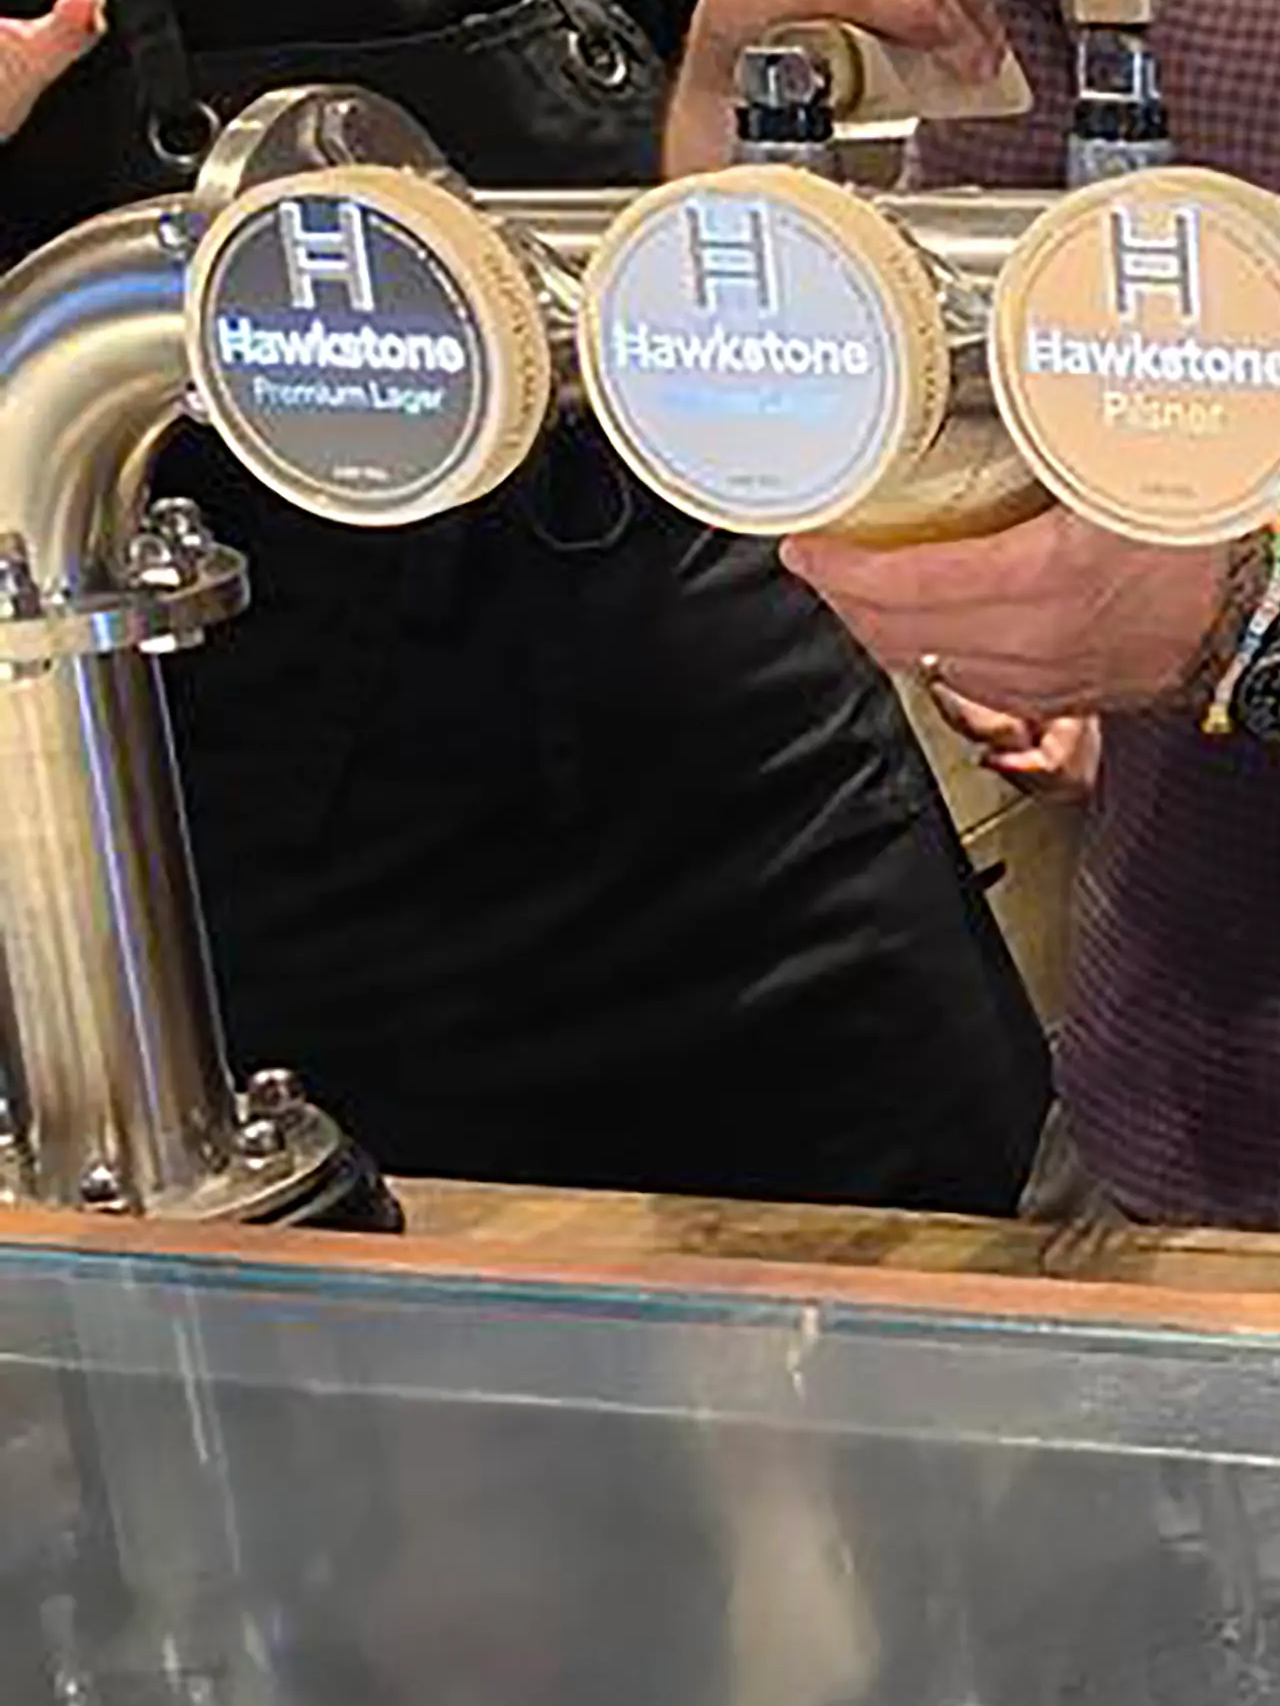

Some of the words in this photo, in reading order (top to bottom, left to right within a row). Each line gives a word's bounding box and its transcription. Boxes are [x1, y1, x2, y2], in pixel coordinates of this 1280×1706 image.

[217, 316, 466, 374] Hawkstone
[613, 321, 869, 375] Hawkstone
[253, 375, 366, 406] Premium
[369, 380, 443, 413] Lager
